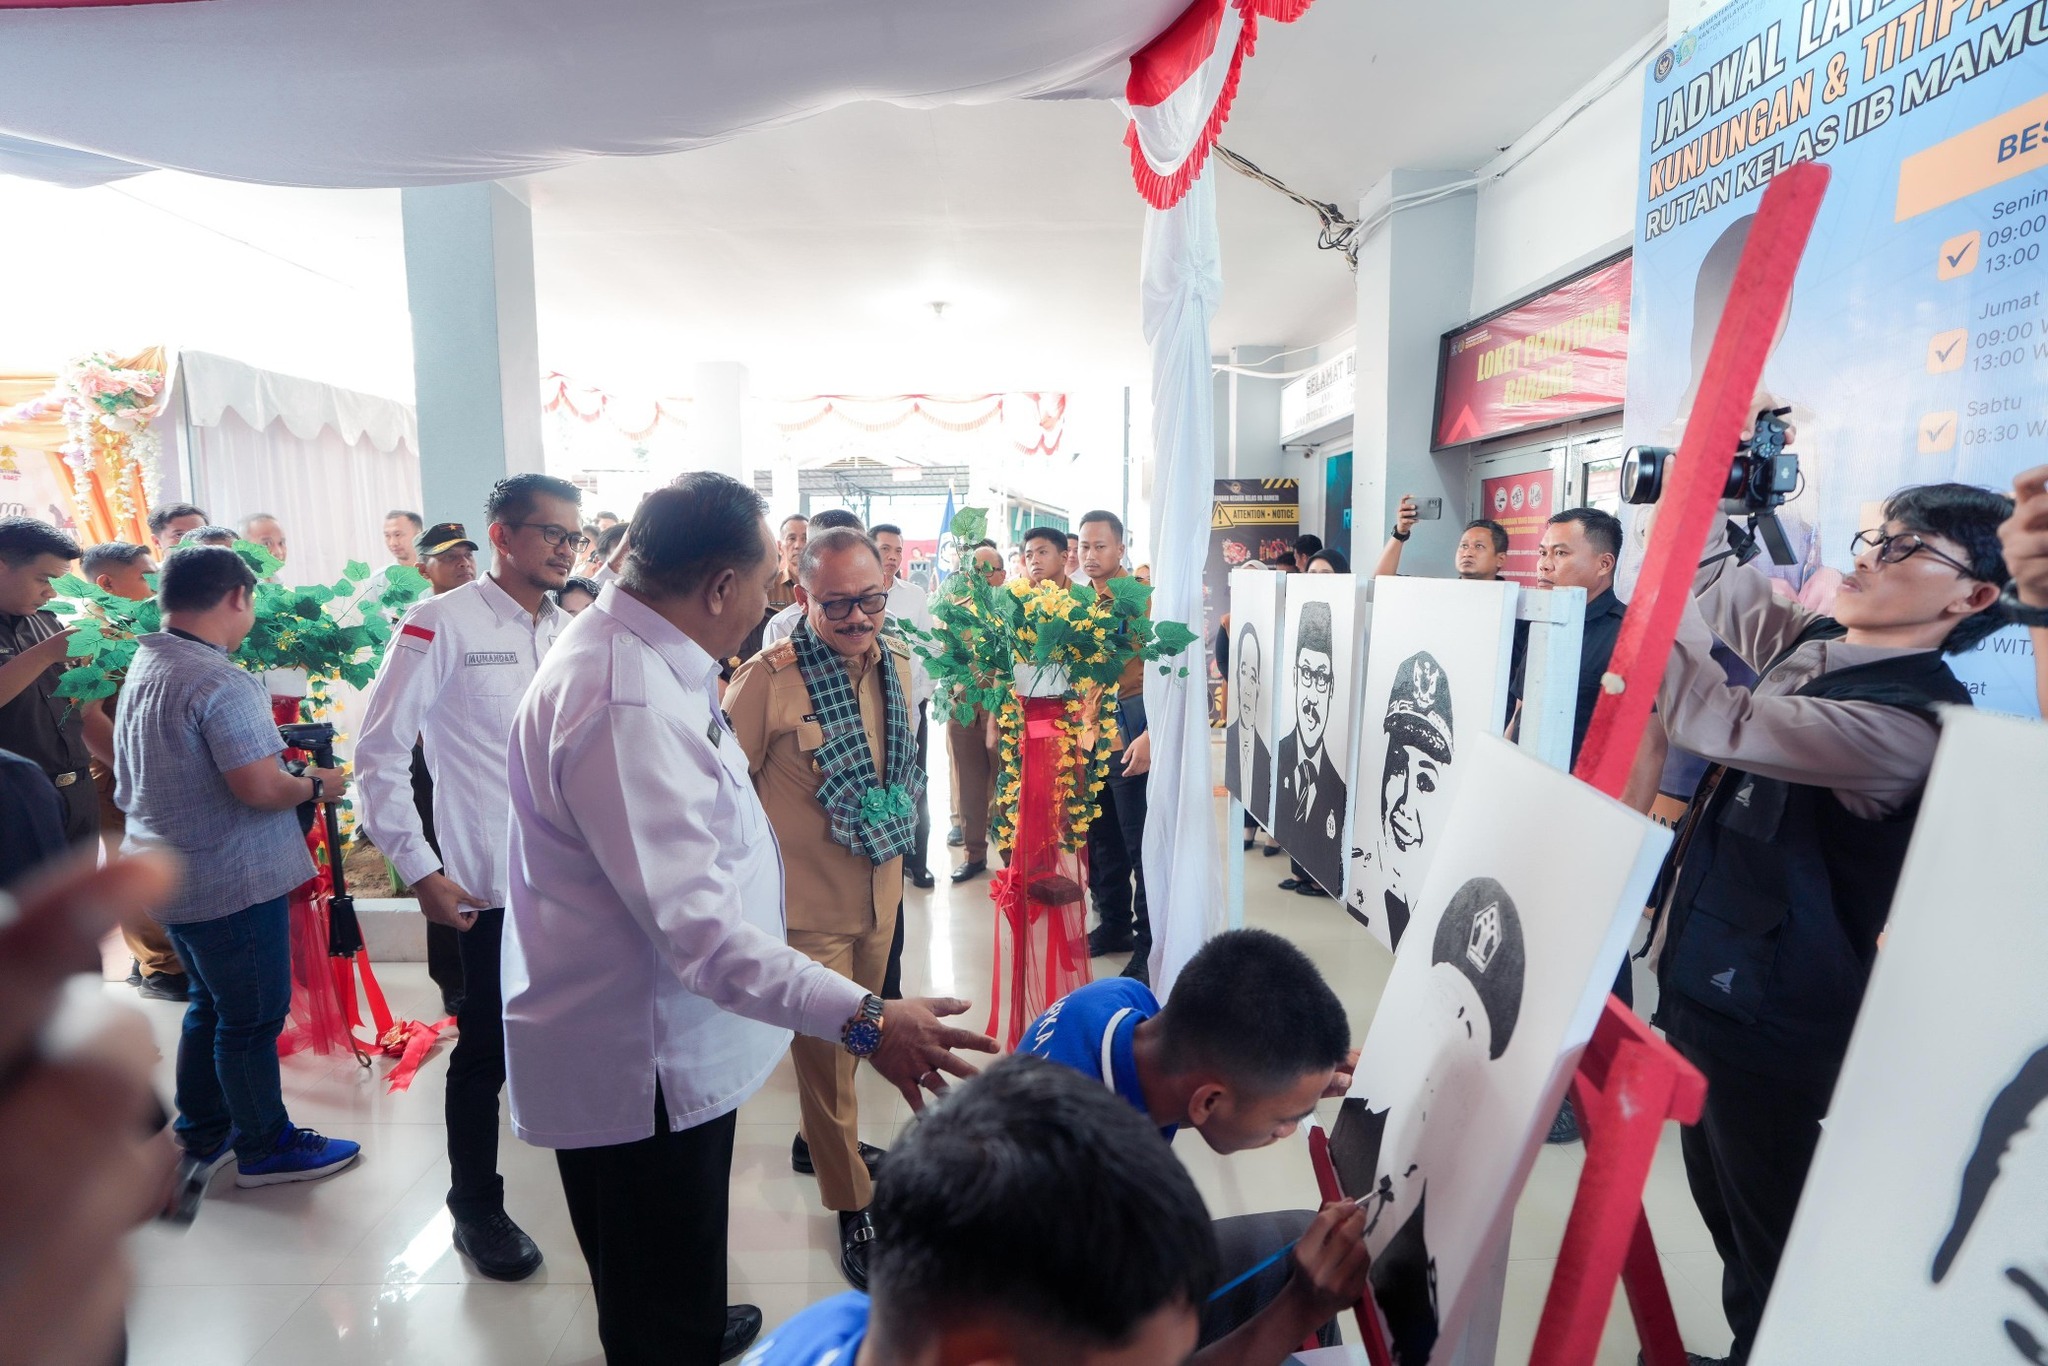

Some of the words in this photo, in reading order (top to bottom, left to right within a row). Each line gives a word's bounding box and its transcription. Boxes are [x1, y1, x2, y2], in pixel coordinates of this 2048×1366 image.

[1651, 18, 1786, 154] JADWAL
[1648, 68, 1814, 203] KUNJUNGAN
[1822, 51, 1849, 105] &
[1645, 169, 1732, 242] RUTAN
[1735, 115, 1840, 198] KELAS
[1844, 85, 1894, 144] IIB
[1992, 188, 2048, 220] Senin
[1987, 214, 2047, 248] 09:00
[1985, 243, 2040, 274] 13:00
[1978, 290, 2040, 320] Jumat
[1477, 339, 1522, 382] LOKET
[1524, 302, 1620, 366] PENITIPAN
[1976, 321, 2033, 350] 09:00
[1973, 347, 2025, 372] 13:00
[1306, 357, 1344, 398] SELAMAT
[1967, 396, 2022, 417] Sabtu
[1964, 423, 2019, 446] 08:30
[1233, 509, 1265, 519] ATTENTION
[1272, 509, 1294, 519] NOTICE
[1993, 637, 2035, 656] WIT
